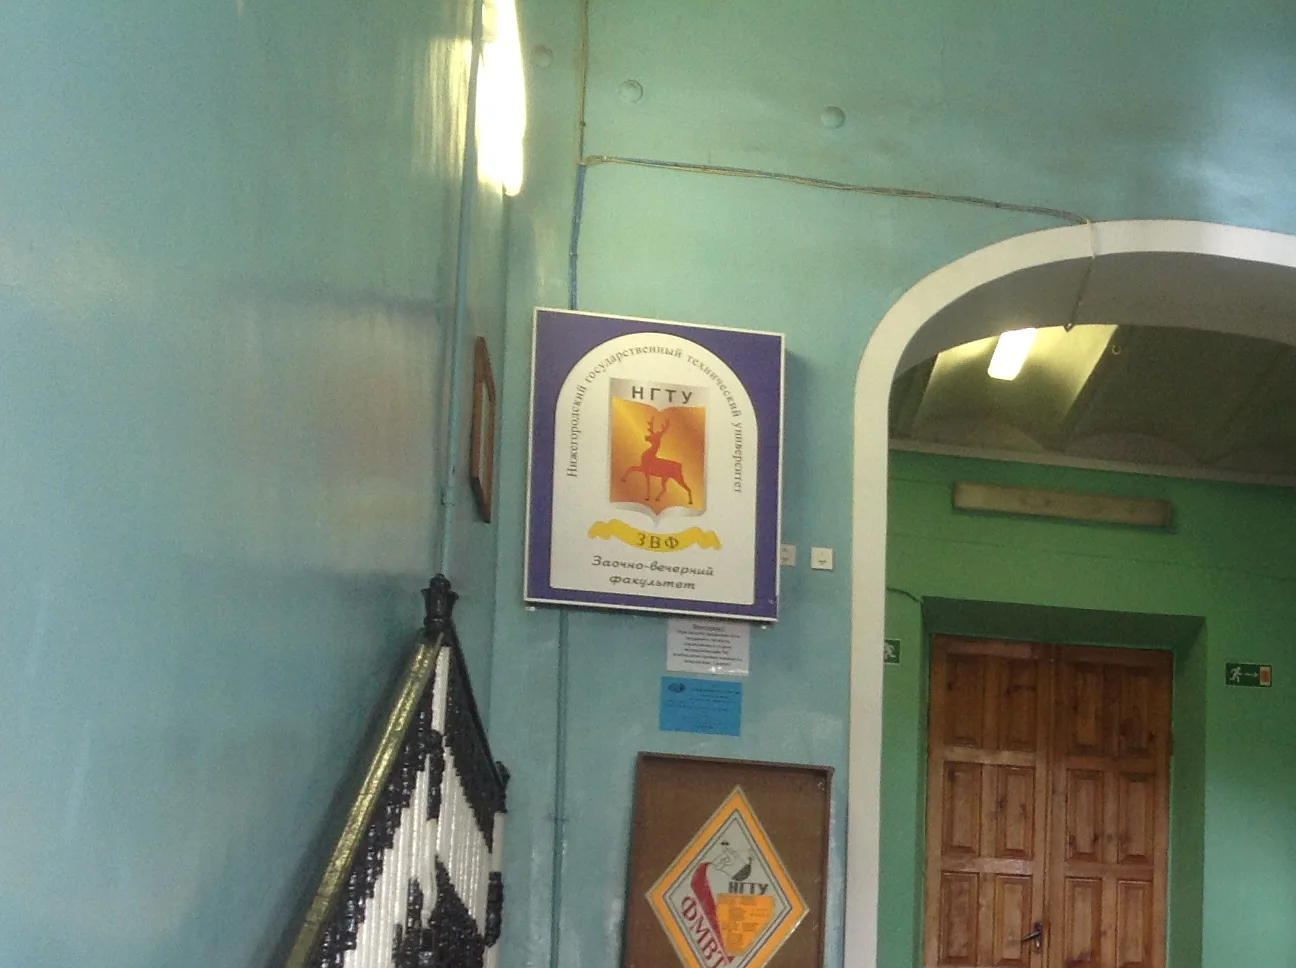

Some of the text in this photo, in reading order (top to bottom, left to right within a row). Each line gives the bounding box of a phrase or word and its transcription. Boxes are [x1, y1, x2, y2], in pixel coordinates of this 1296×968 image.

[631, 385, 693, 404] НГТУ
[566, 345, 743, 494] Нижегородский государственный технический университет
[635, 532, 680, 549] ЗВФ
[591, 555, 714, 577] Заочно-вечерний
[609, 574, 696, 590] факультет
[728, 881, 769, 895] НГТУ
